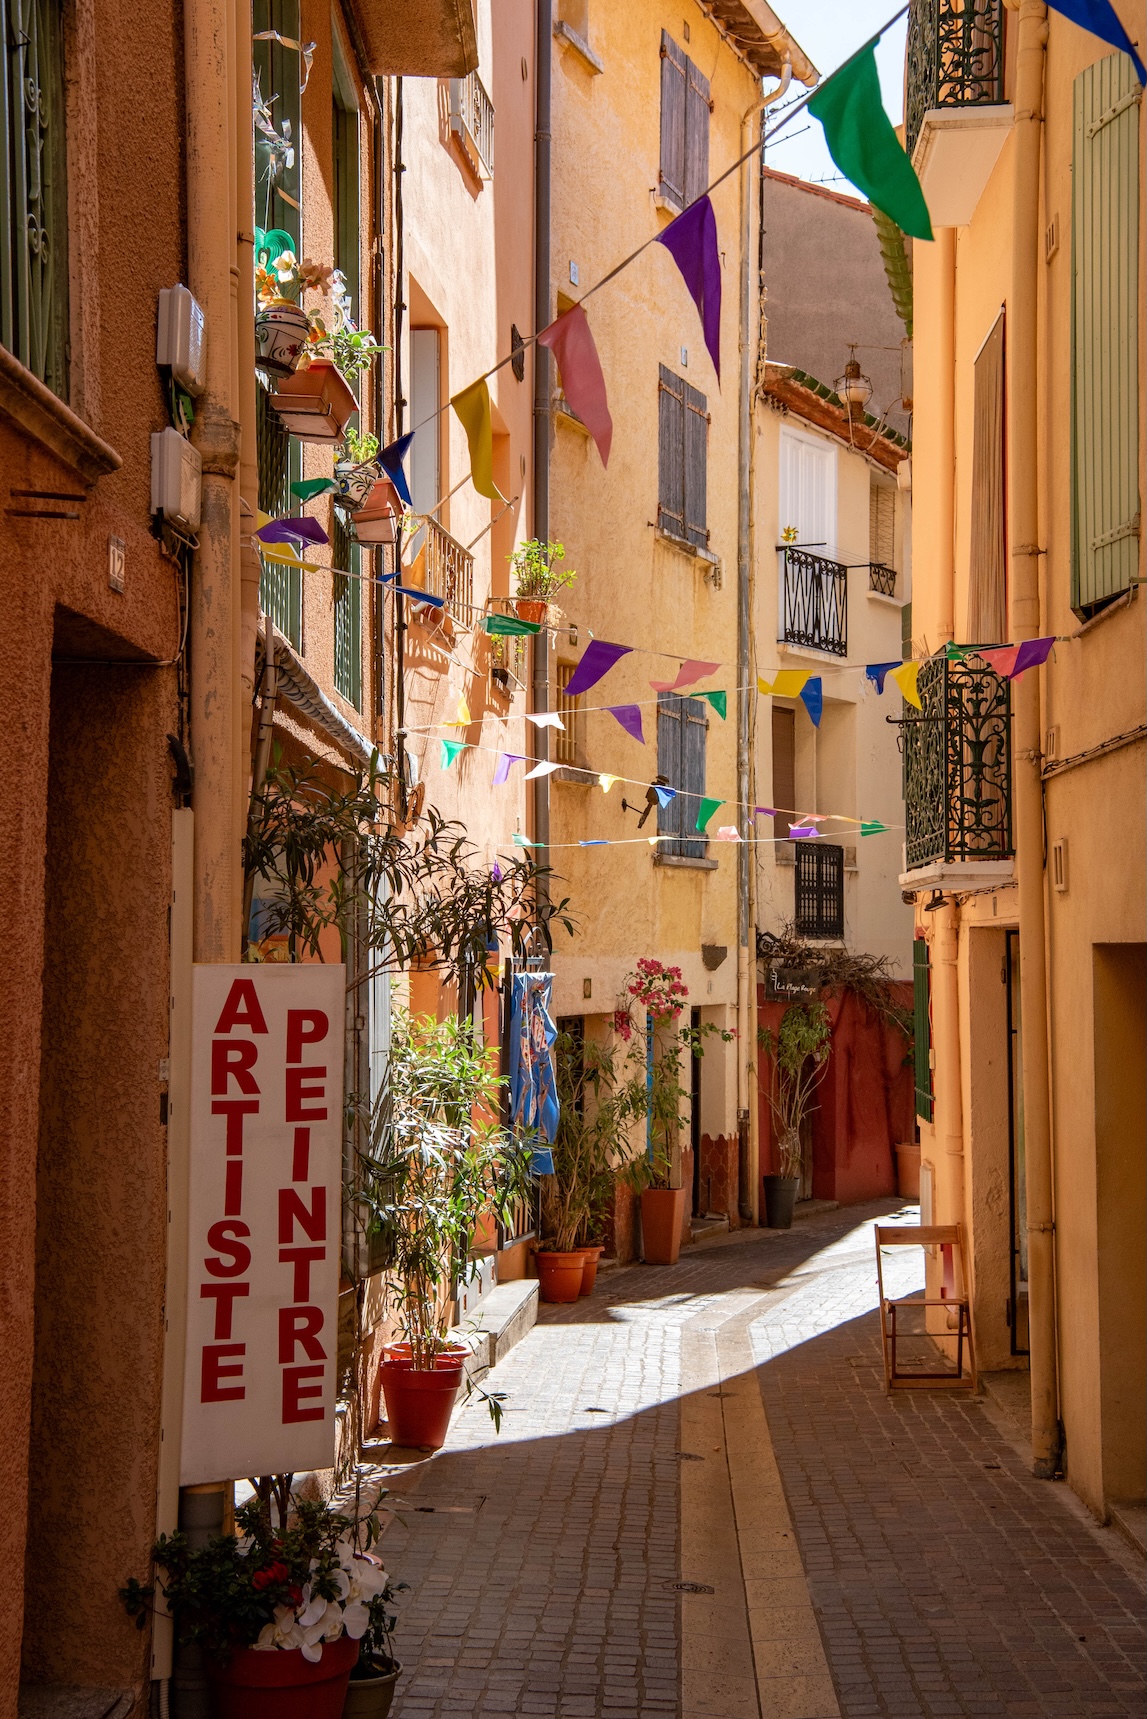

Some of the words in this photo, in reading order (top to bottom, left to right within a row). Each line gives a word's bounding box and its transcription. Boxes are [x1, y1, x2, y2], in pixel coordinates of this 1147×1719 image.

[111, 548, 125, 580] 12
[201, 978, 268, 1403] ARTISTE
[278, 1009, 329, 1425] PEINTRE
